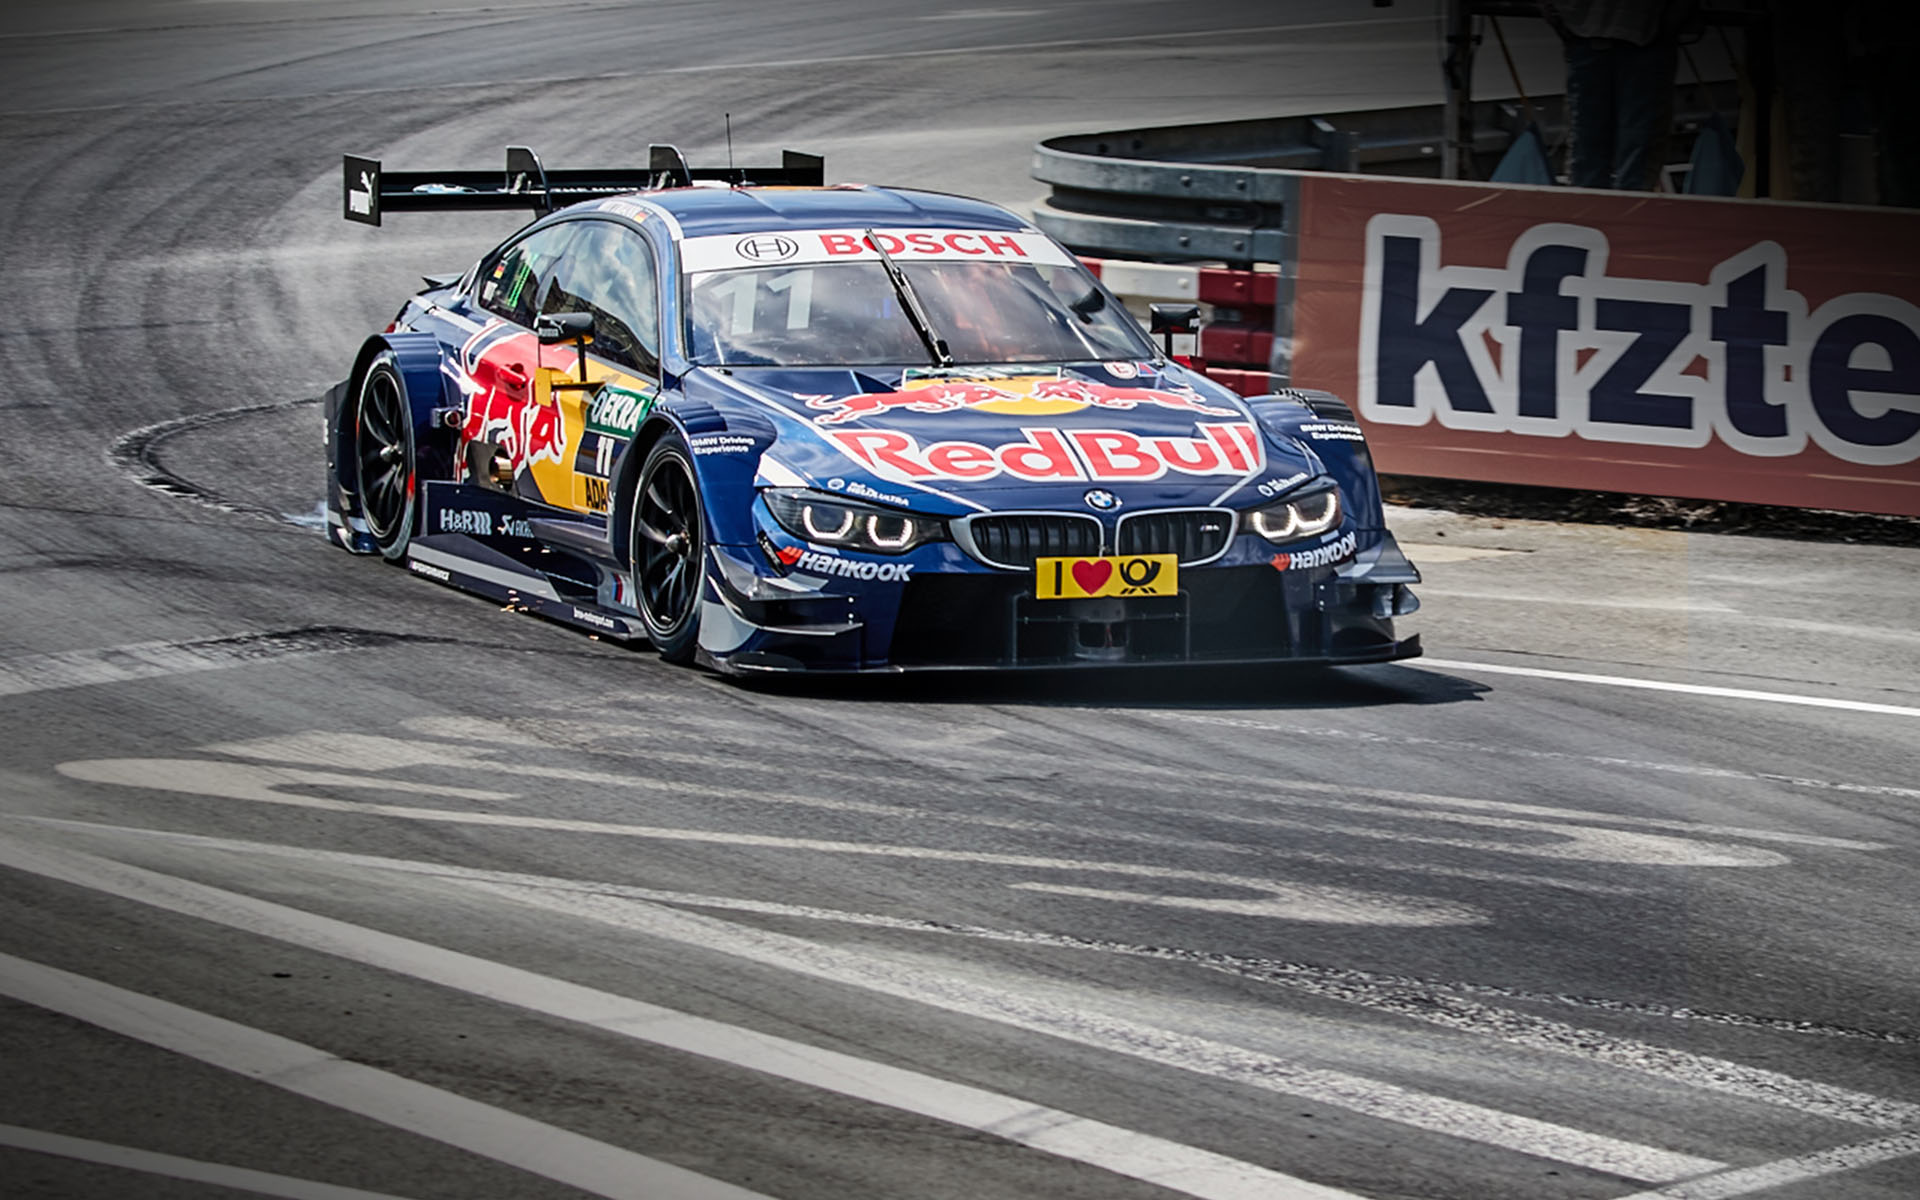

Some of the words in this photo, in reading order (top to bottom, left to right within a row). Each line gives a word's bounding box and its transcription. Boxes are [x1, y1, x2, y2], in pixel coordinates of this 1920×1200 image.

[818, 233, 1029, 257] BOSCH
[709, 269, 814, 336] 11
[591, 390, 646, 433] DEKRA
[691, 437, 718, 446] BMW
[719, 436, 755, 446] Driving
[1311, 432, 1365, 442] Experience
[1327, 424, 1362, 434] Driving
[596, 434, 616, 477] 11
[693, 445, 749, 455] Experience
[584, 477, 609, 512] ADA
[1053, 560, 1063, 596] I
